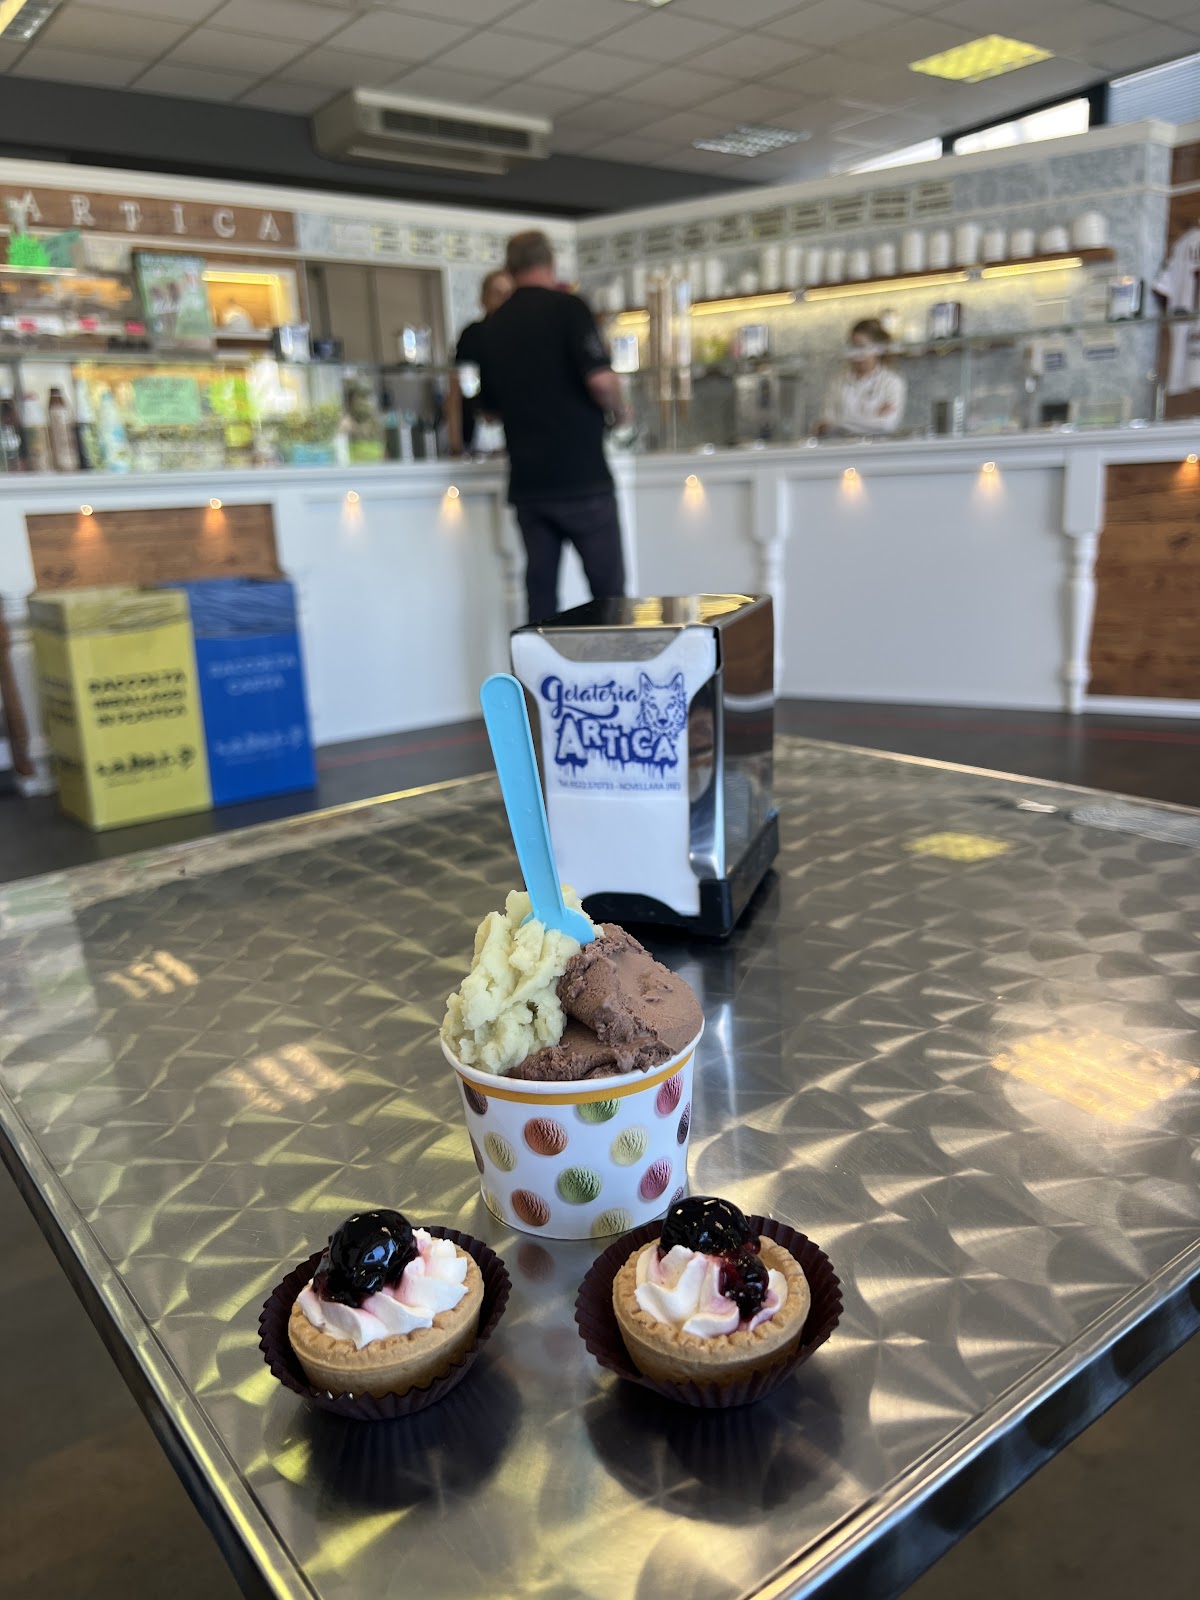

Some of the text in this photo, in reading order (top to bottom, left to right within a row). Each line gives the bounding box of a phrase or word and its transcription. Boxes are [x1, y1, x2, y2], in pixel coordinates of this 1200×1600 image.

[20, 190, 282, 242] ARTICA
[541, 676, 638, 719] Gelateria
[555, 713, 678, 769] ARTICA
